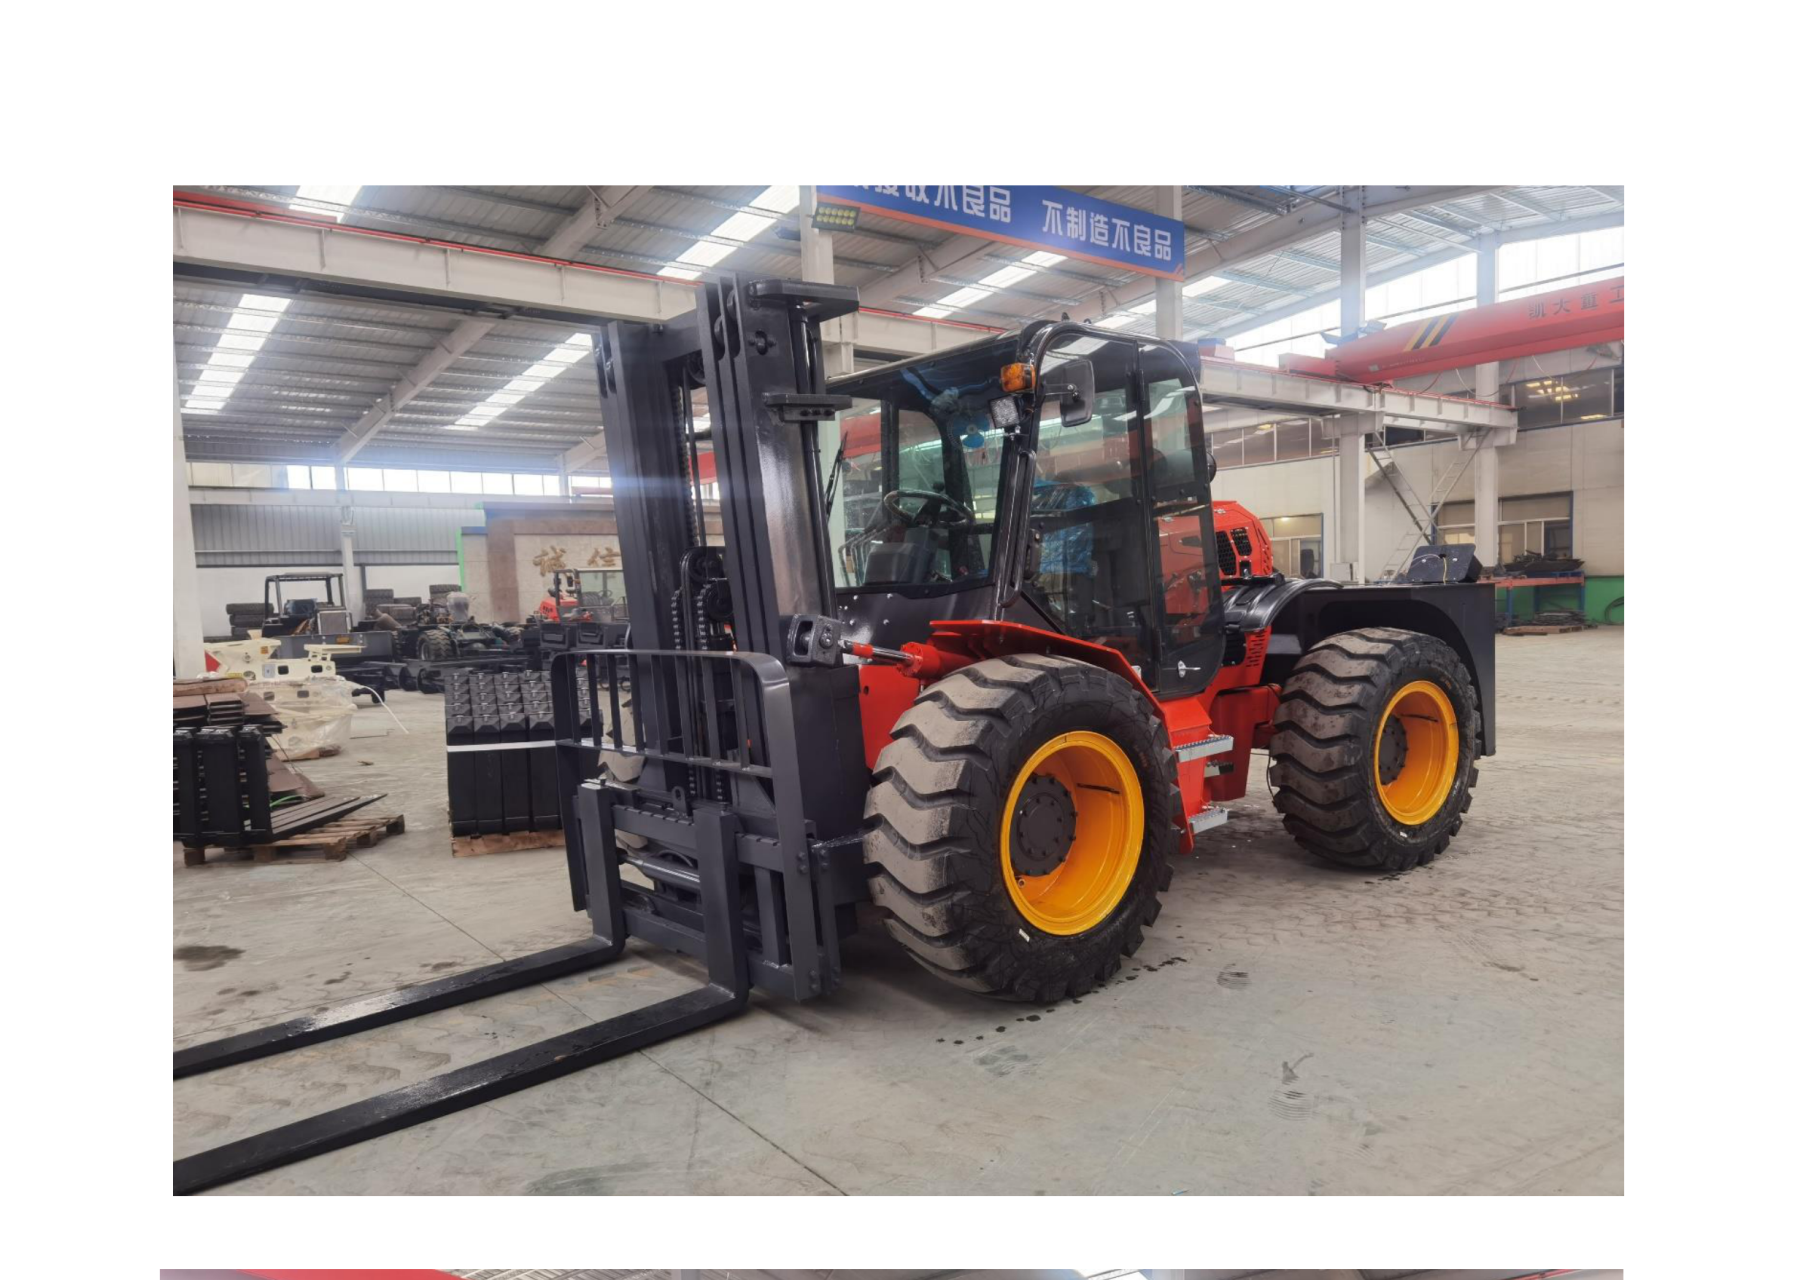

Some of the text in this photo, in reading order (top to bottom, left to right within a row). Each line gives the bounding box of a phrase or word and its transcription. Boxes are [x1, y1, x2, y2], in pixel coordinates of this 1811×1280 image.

[1042, 199, 1171, 261] 不制造不良品
